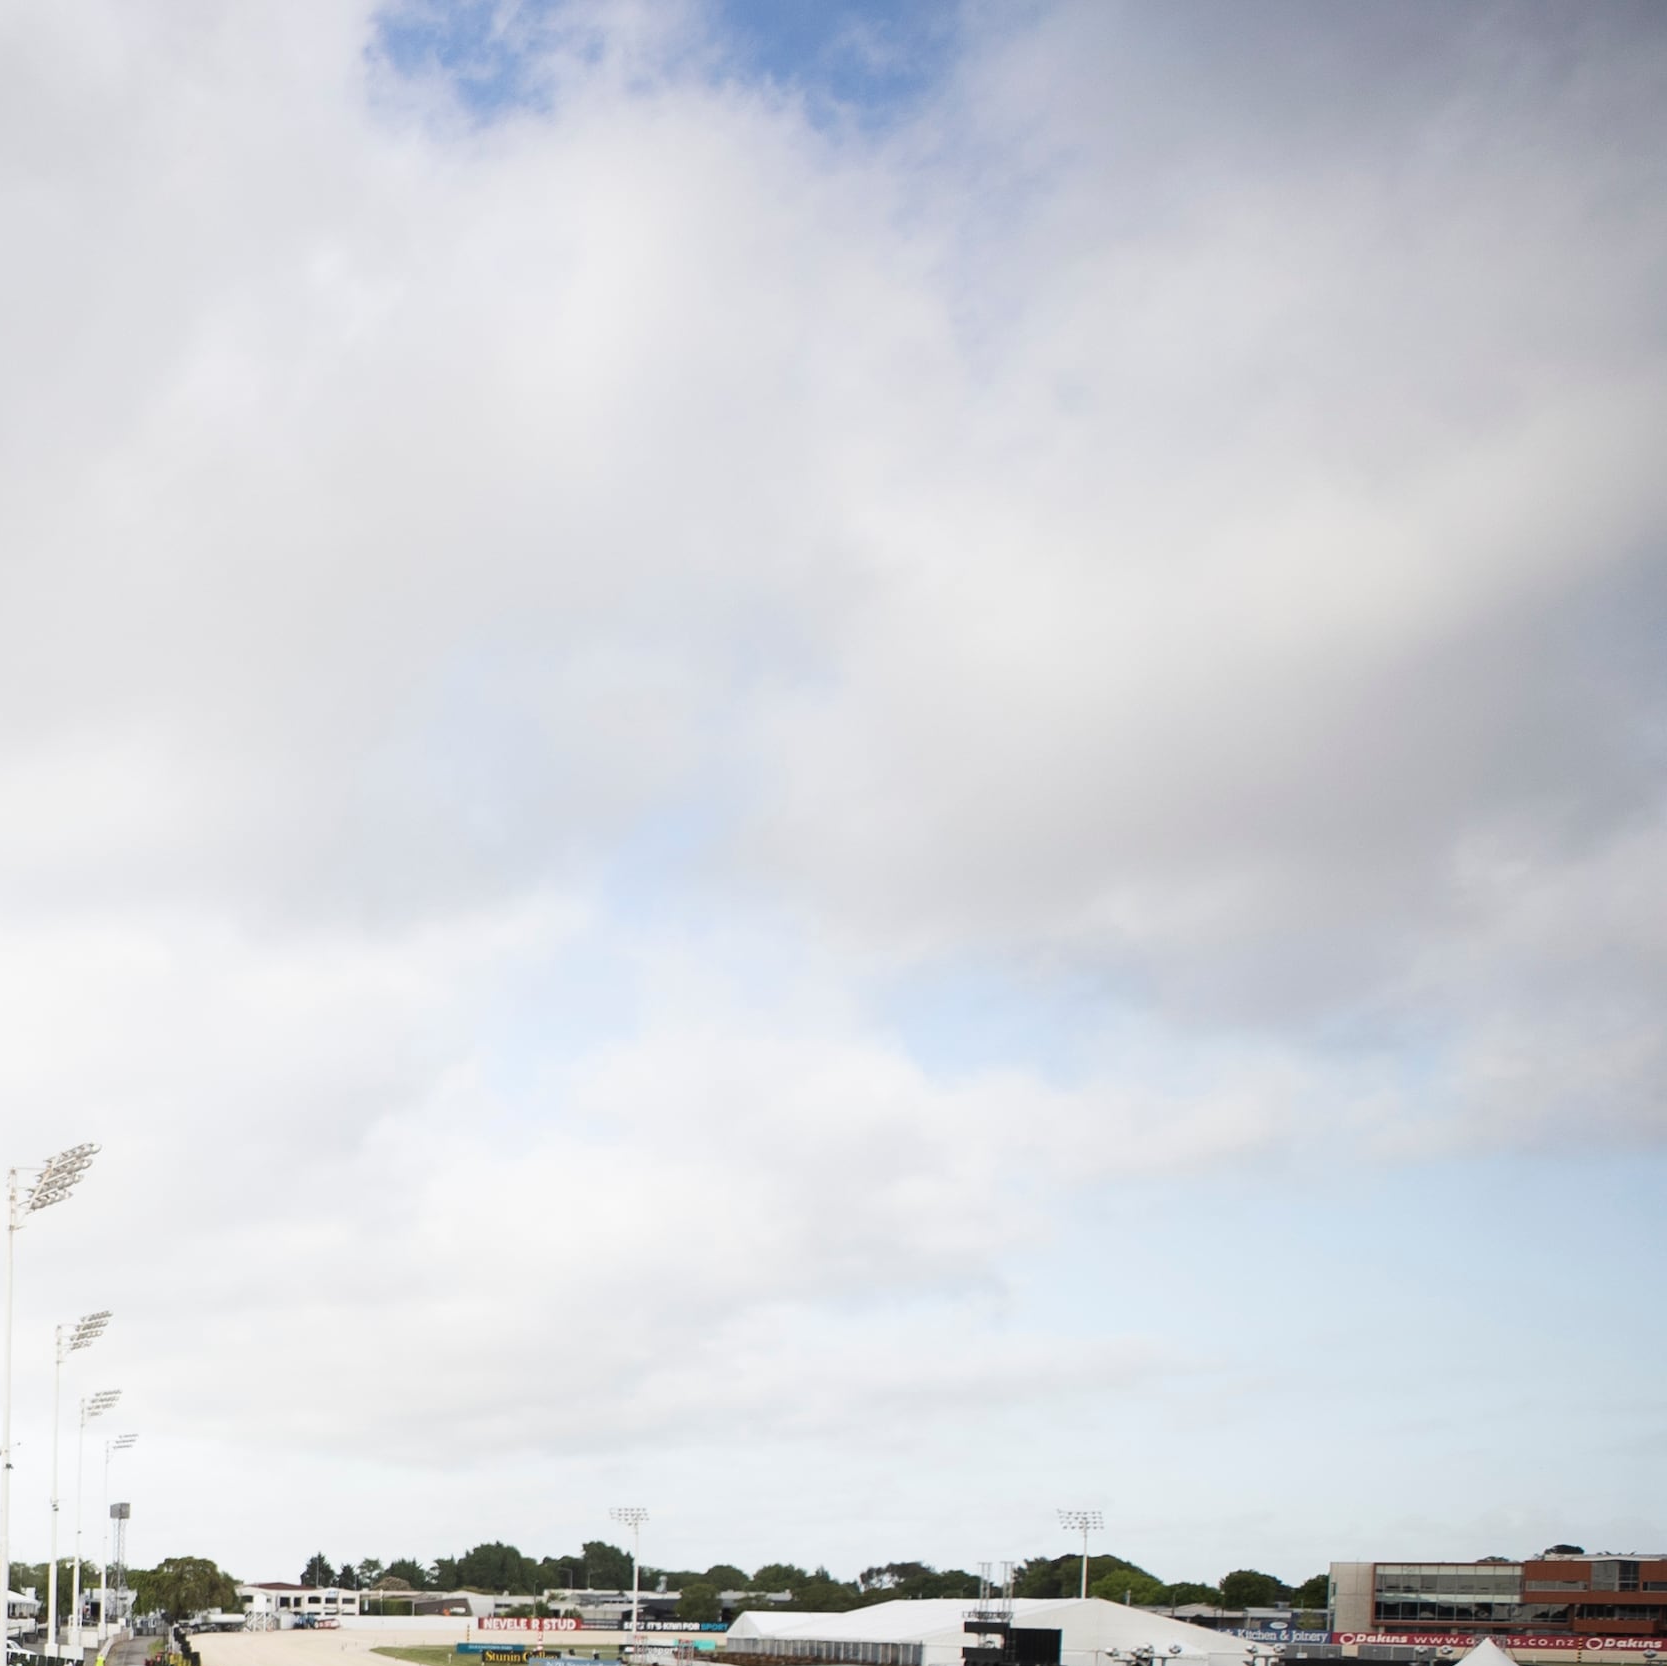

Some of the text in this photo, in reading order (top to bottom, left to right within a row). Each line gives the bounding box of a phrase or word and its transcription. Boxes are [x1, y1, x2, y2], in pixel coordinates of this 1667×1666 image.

[484, 1619, 527, 1630] NEVELE
[531, 1619, 540, 1630] R
[543, 1619, 577, 1630] STUD
[683, 1622, 700, 1631] FOR
[701, 1622, 728, 1631] SPORT
[1237, 1629, 1277, 1640] Kitchen
[1279, 1630, 1289, 1641] &
[1291, 1630, 1328, 1643] Joinery
